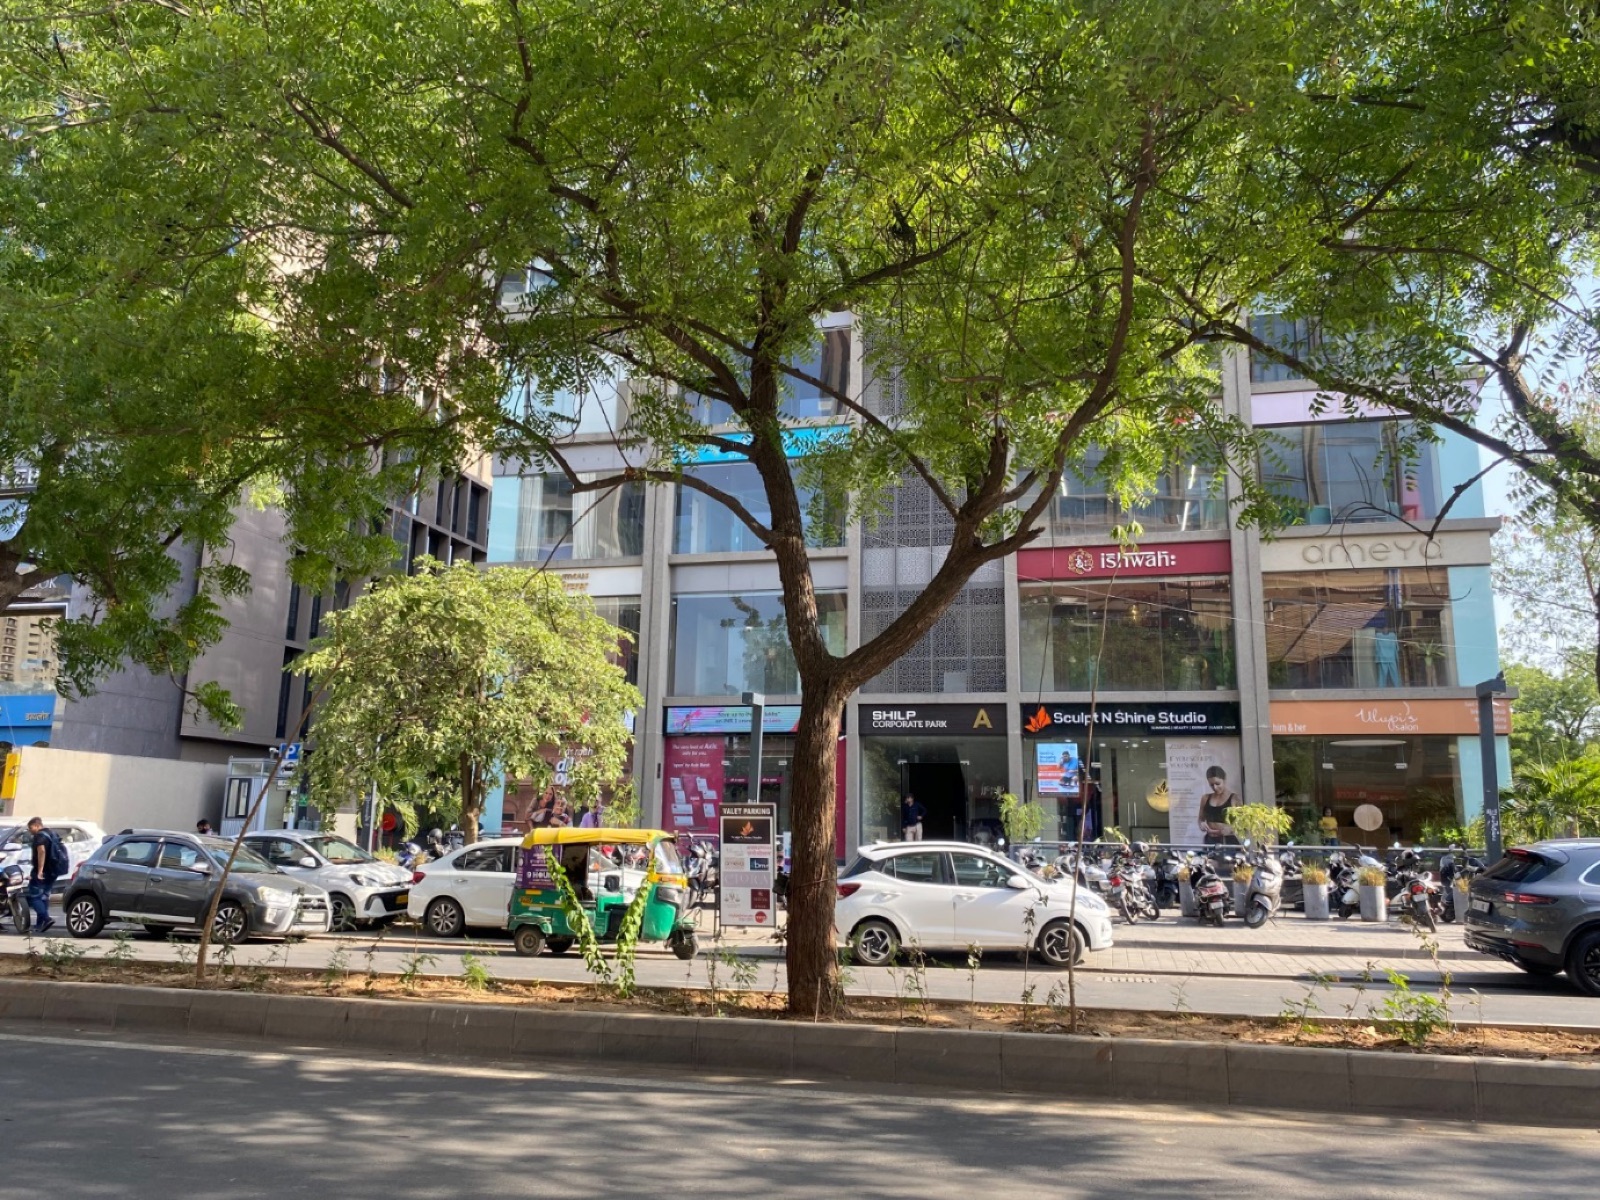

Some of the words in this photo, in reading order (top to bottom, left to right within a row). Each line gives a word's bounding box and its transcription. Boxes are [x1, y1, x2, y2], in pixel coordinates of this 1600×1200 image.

[872, 710, 916, 720] SHILP
[972, 707, 993, 729] A
[1053, 711, 1099, 726] Sculpt
[1101, 711, 1112, 723] N
[1114, 711, 1156, 724] Shine
[1158, 711, 1207, 724] Studio
[872, 720, 924, 729] CORPORATE
[925, 720, 947, 729] PARK
[1294, 722, 1307, 732] her
[1394, 721, 1419, 732] salon
[722, 807, 742, 815] VALET
[743, 807, 771, 815] PARKING
